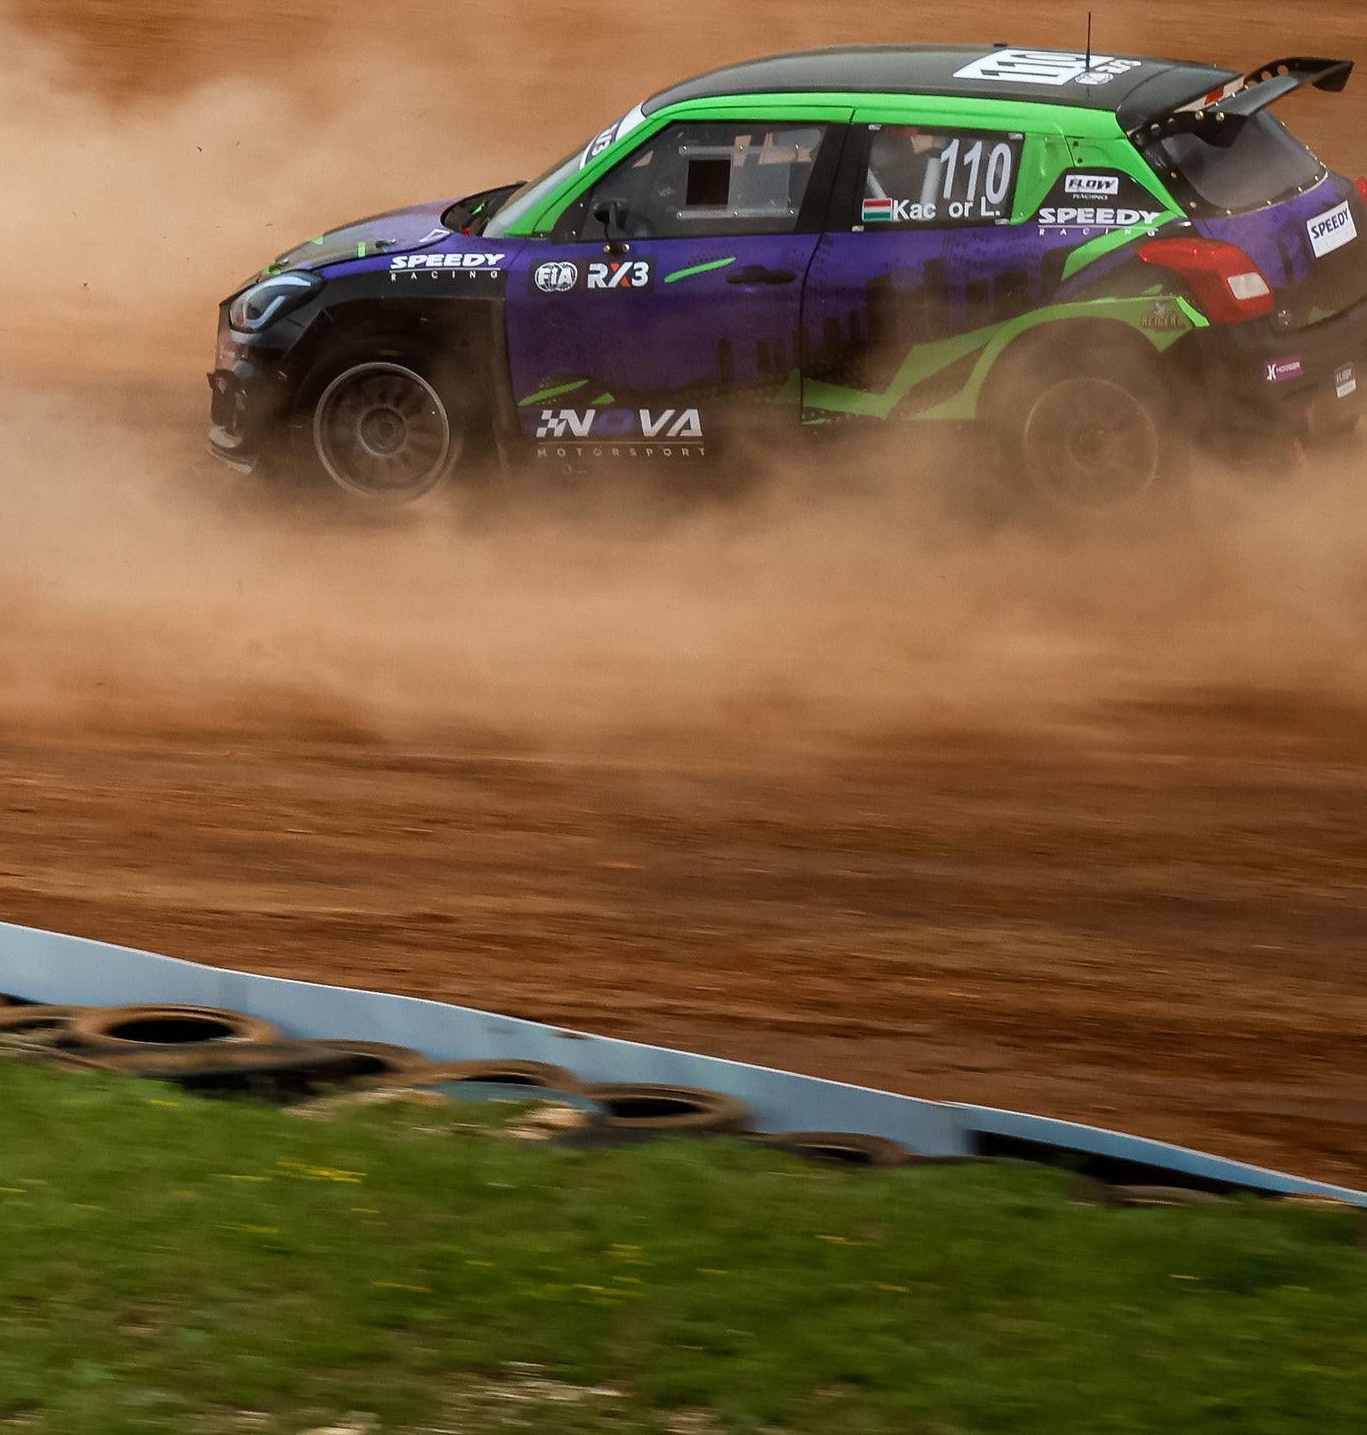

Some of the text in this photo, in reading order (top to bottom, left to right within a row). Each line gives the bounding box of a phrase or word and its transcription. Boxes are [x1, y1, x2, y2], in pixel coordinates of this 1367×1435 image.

[940, 138, 1011, 204] 110
[981, 196, 1001, 217] L.
[1038, 207, 1160, 225] SPEEDY
[1039, 227, 1158, 238] RACING
[1311, 208, 1350, 240] SPEEDY
[390, 253, 506, 269] SPEEDY
[389, 270, 499, 283] RACING
[537, 261, 650, 288] FIA RX3
[551, 408, 704, 437] NOVA
[536, 447, 708, 458] MOTORSPORT
